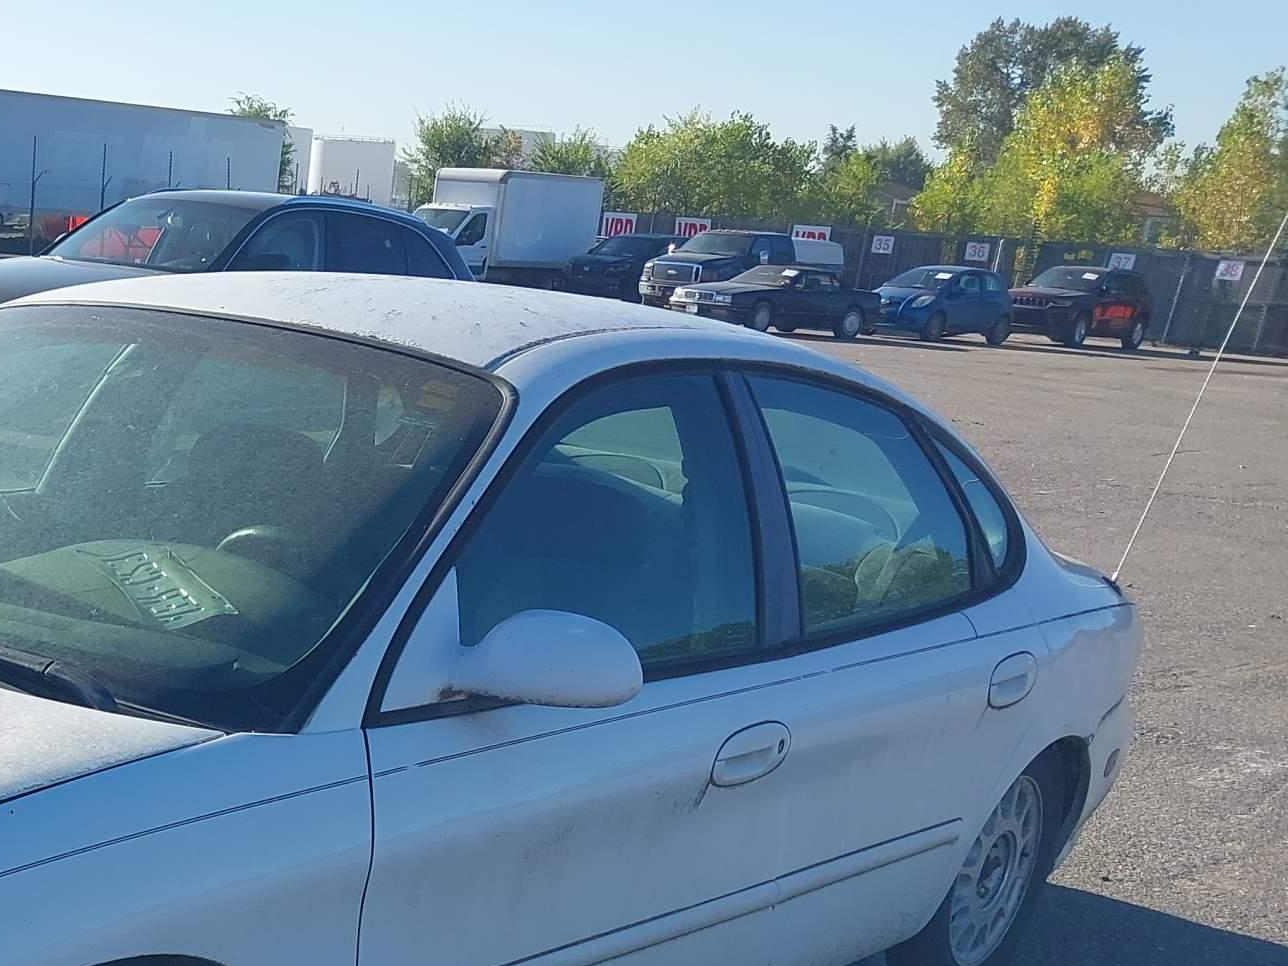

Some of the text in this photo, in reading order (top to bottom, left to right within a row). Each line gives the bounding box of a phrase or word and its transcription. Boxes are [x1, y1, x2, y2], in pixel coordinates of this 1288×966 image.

[875, 238, 890, 252] 35
[968, 244, 986, 259] 36
[1112, 255, 1131, 270] 37
